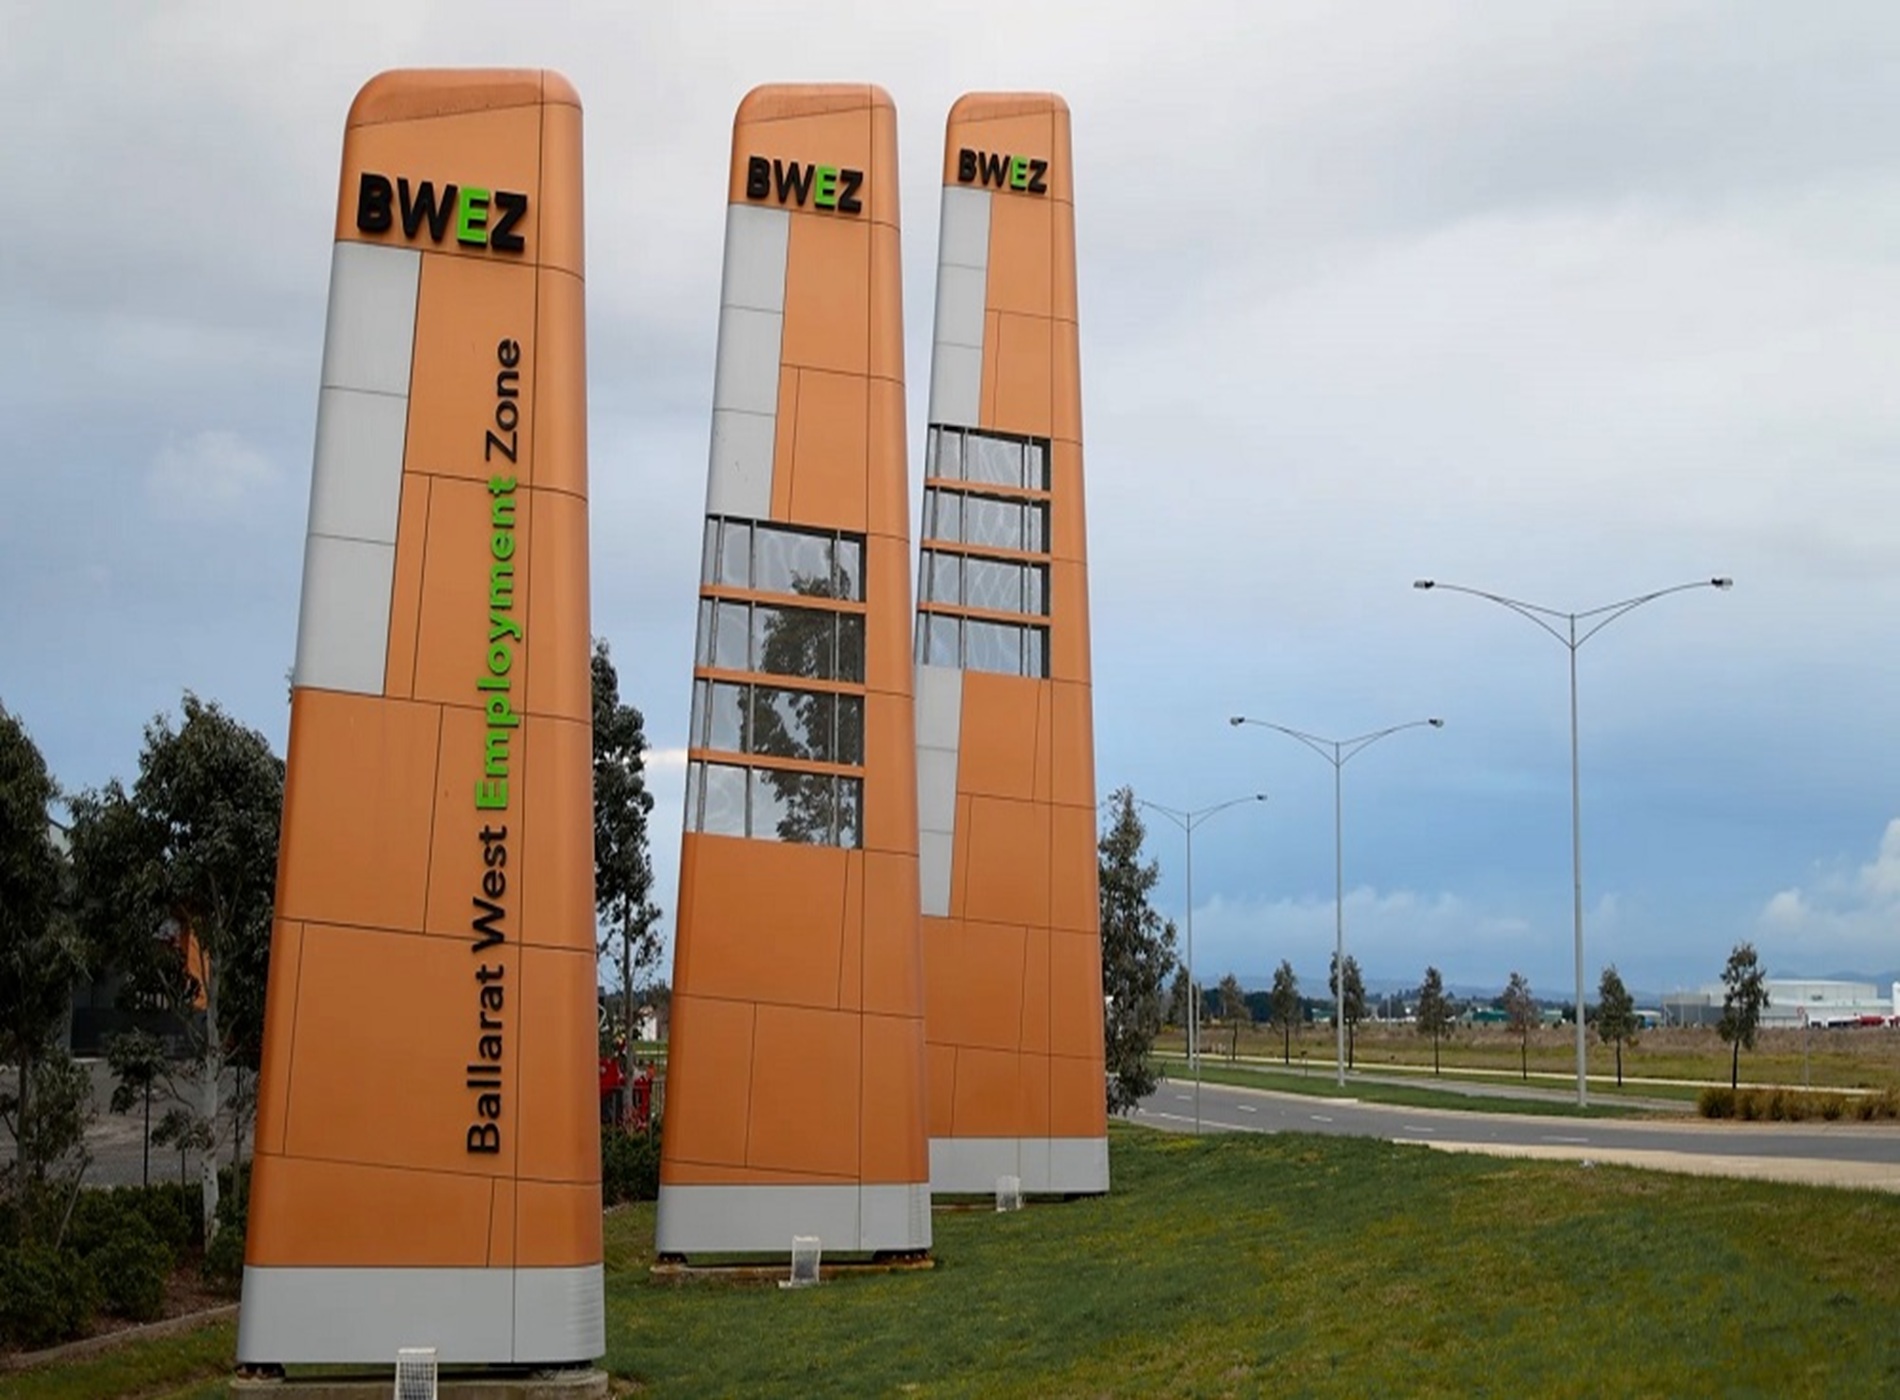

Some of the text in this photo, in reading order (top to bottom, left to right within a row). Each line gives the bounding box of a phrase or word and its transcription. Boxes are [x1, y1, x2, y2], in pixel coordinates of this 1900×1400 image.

[746, 155, 863, 214] BWEZ
[958, 148, 1048, 193] BWEZ
[356, 172, 528, 252] BWEZ
[466, 338, 522, 1155] Ballarat West Employment Zone
